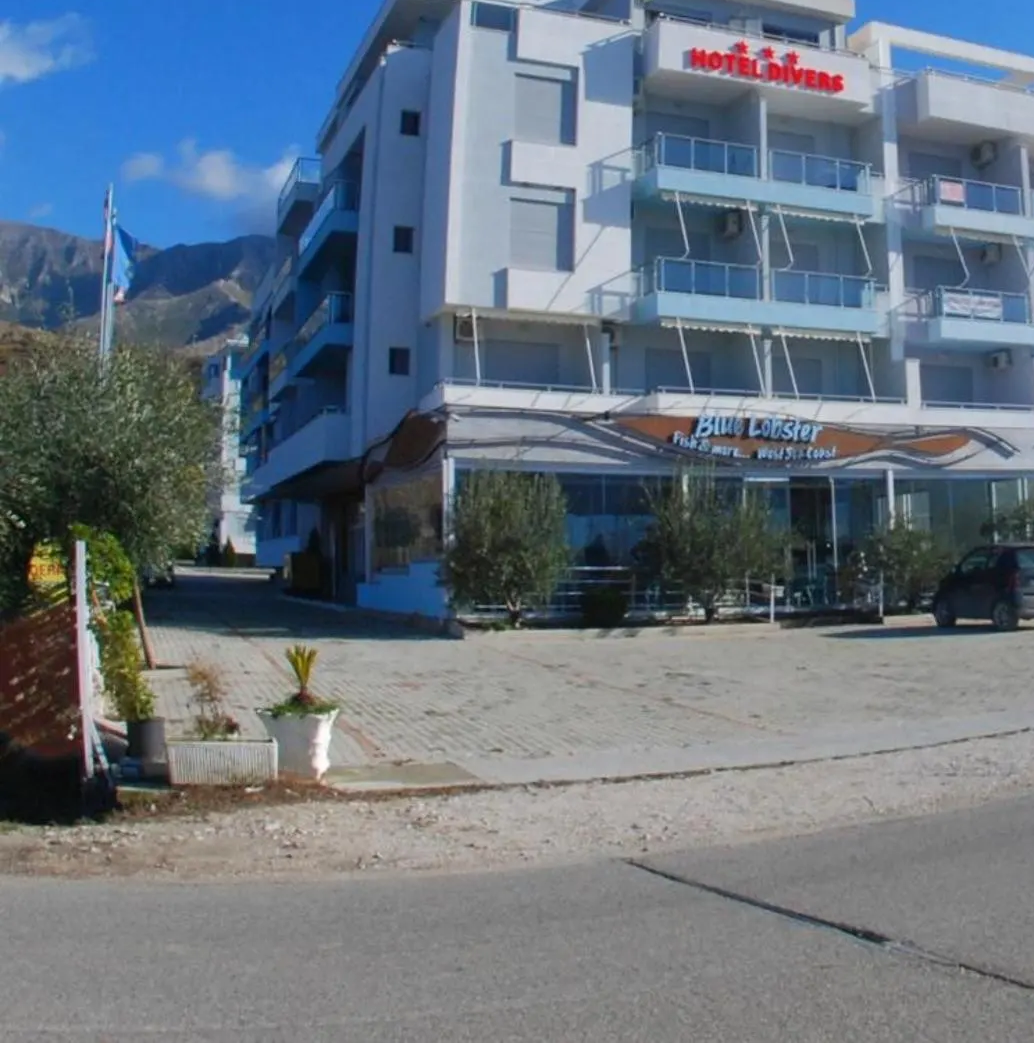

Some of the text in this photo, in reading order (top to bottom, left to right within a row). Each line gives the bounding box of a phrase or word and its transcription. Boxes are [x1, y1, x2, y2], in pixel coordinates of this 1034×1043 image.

[690, 47, 844, 93] HOTEL DIVERS
[672, 430, 698, 450] Fish
[695, 414, 823, 443] Blue Lobster
